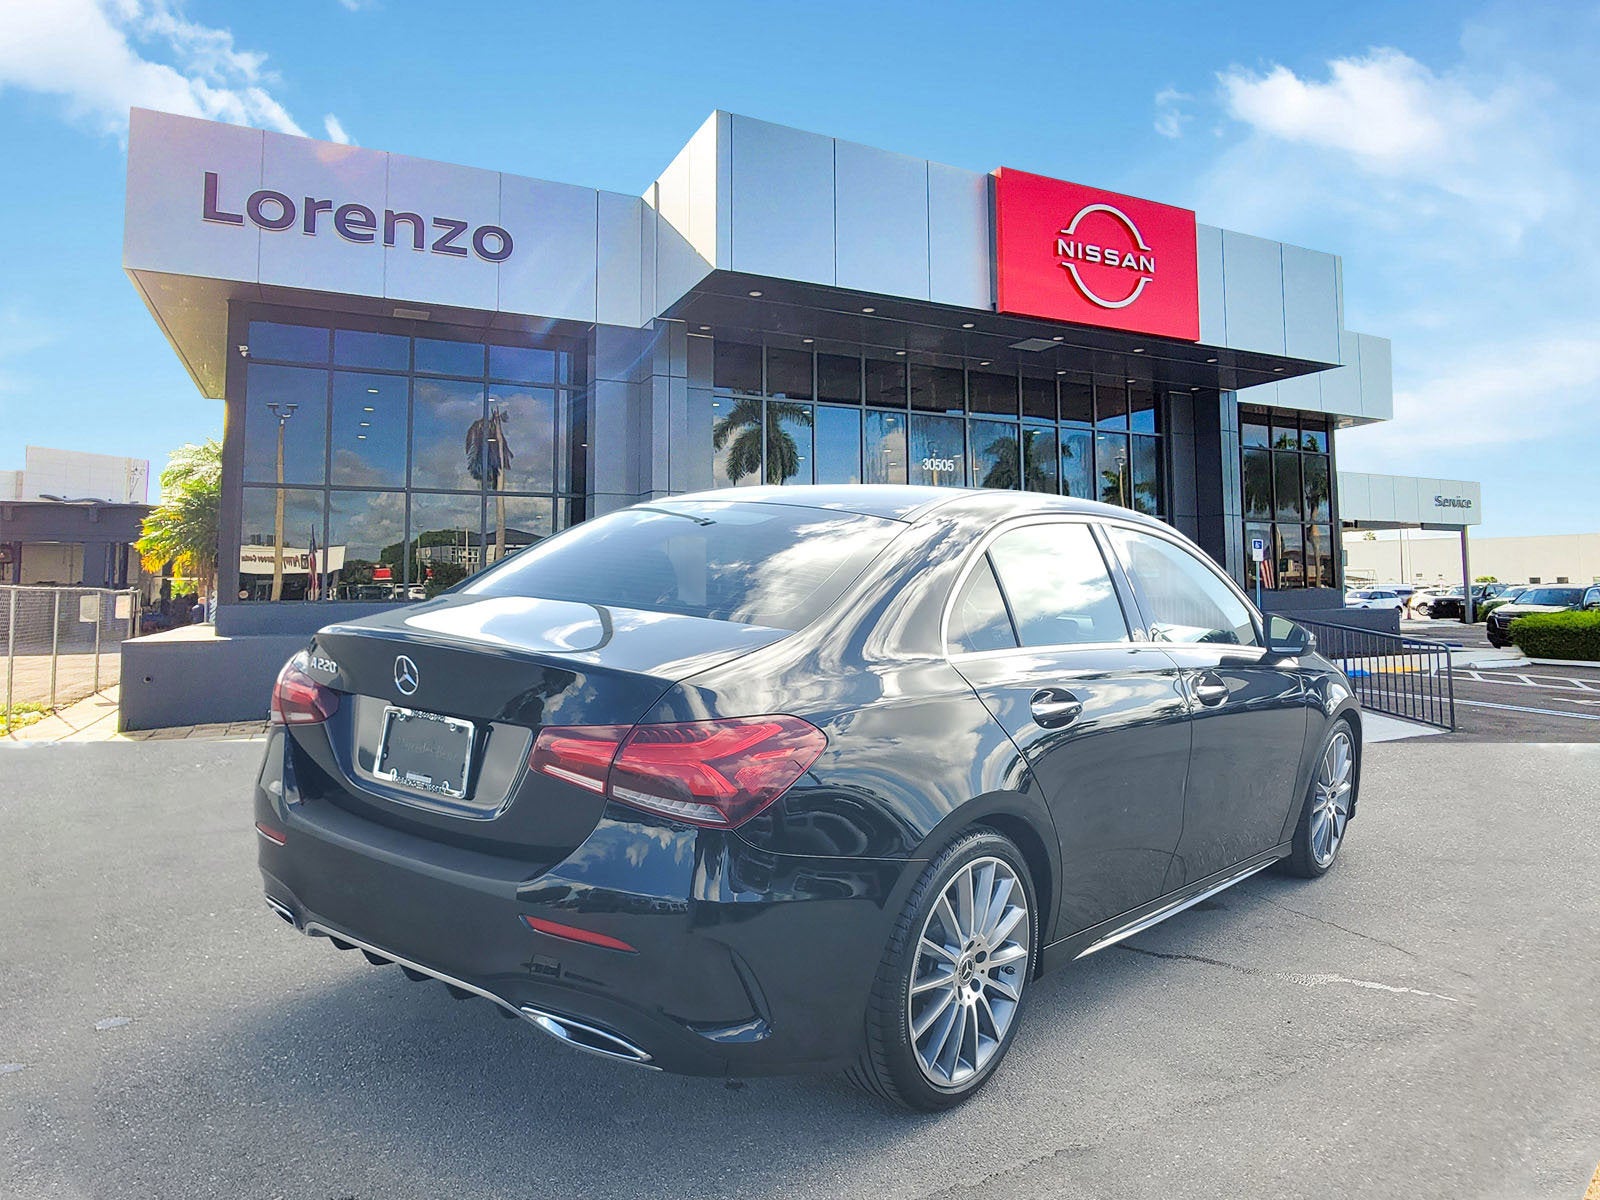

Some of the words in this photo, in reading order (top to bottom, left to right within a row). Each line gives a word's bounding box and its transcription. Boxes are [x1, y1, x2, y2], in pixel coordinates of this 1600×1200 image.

[203, 171, 515, 262] Lorenzo
[1057, 238, 1155, 273] NISSAN
[922, 458, 955, 472] 30505
[1434, 495, 1472, 508] Service
[311, 656, 338, 673] A220
